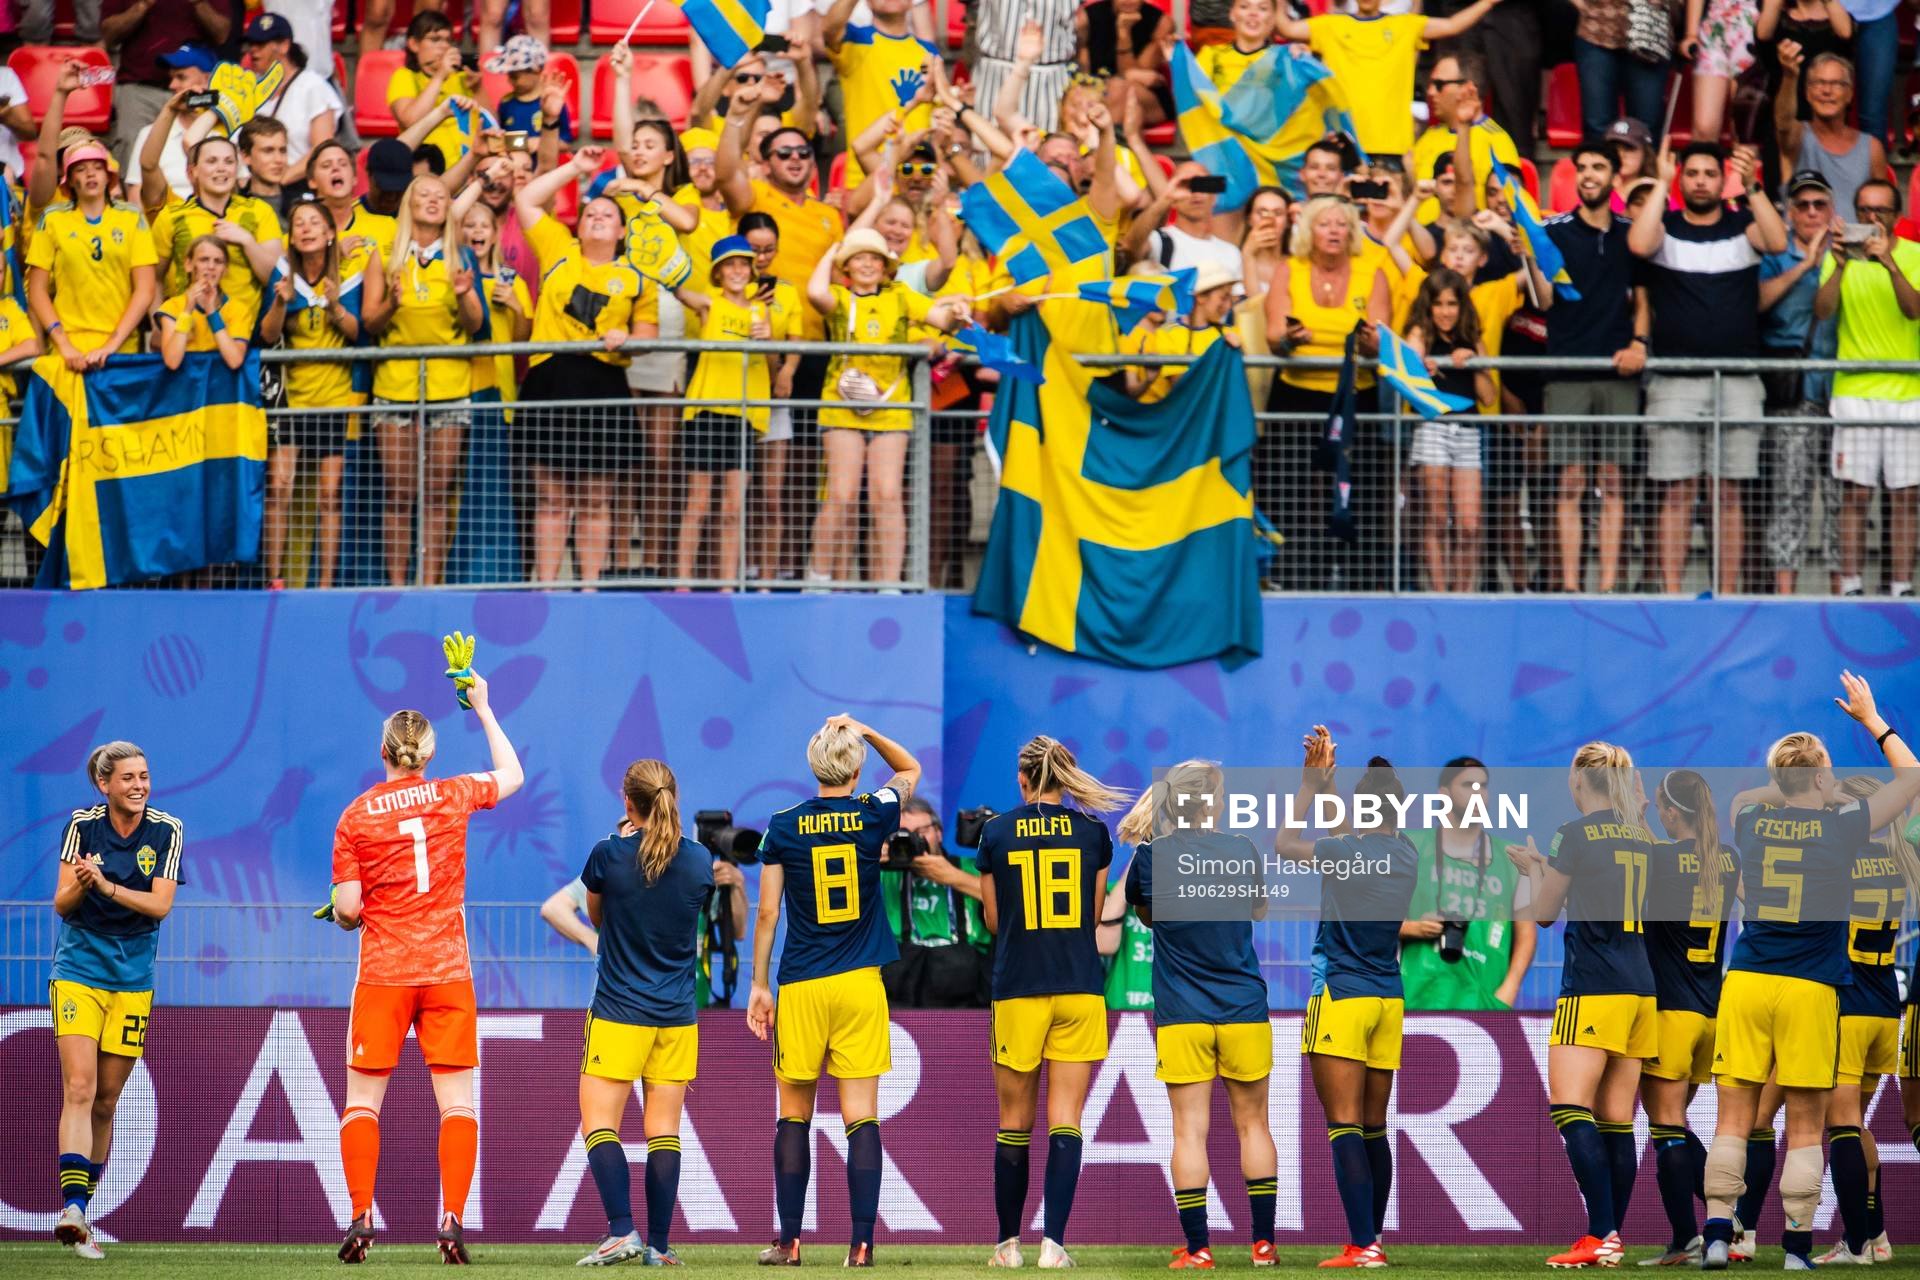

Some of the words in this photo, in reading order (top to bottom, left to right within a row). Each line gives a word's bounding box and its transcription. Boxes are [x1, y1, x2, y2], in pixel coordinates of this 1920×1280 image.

[91, 236, 103, 261] 3
[366, 782, 443, 815] LINDAHL
[798, 811, 864, 835] HURTIG
[1016, 814, 1073, 837] ROLFÖ
[1754, 818, 1823, 841] FISCHER
[397, 816, 430, 893] 1
[1678, 853, 1736, 873] ASNI
[811, 843, 860, 924] 8
[1007, 848, 1082, 930] 18
[1430, 863, 1503, 896] HOO
[1614, 850, 1647, 934] 11
[1757, 846, 1804, 923] 5
[1686, 885, 1725, 963] 9
